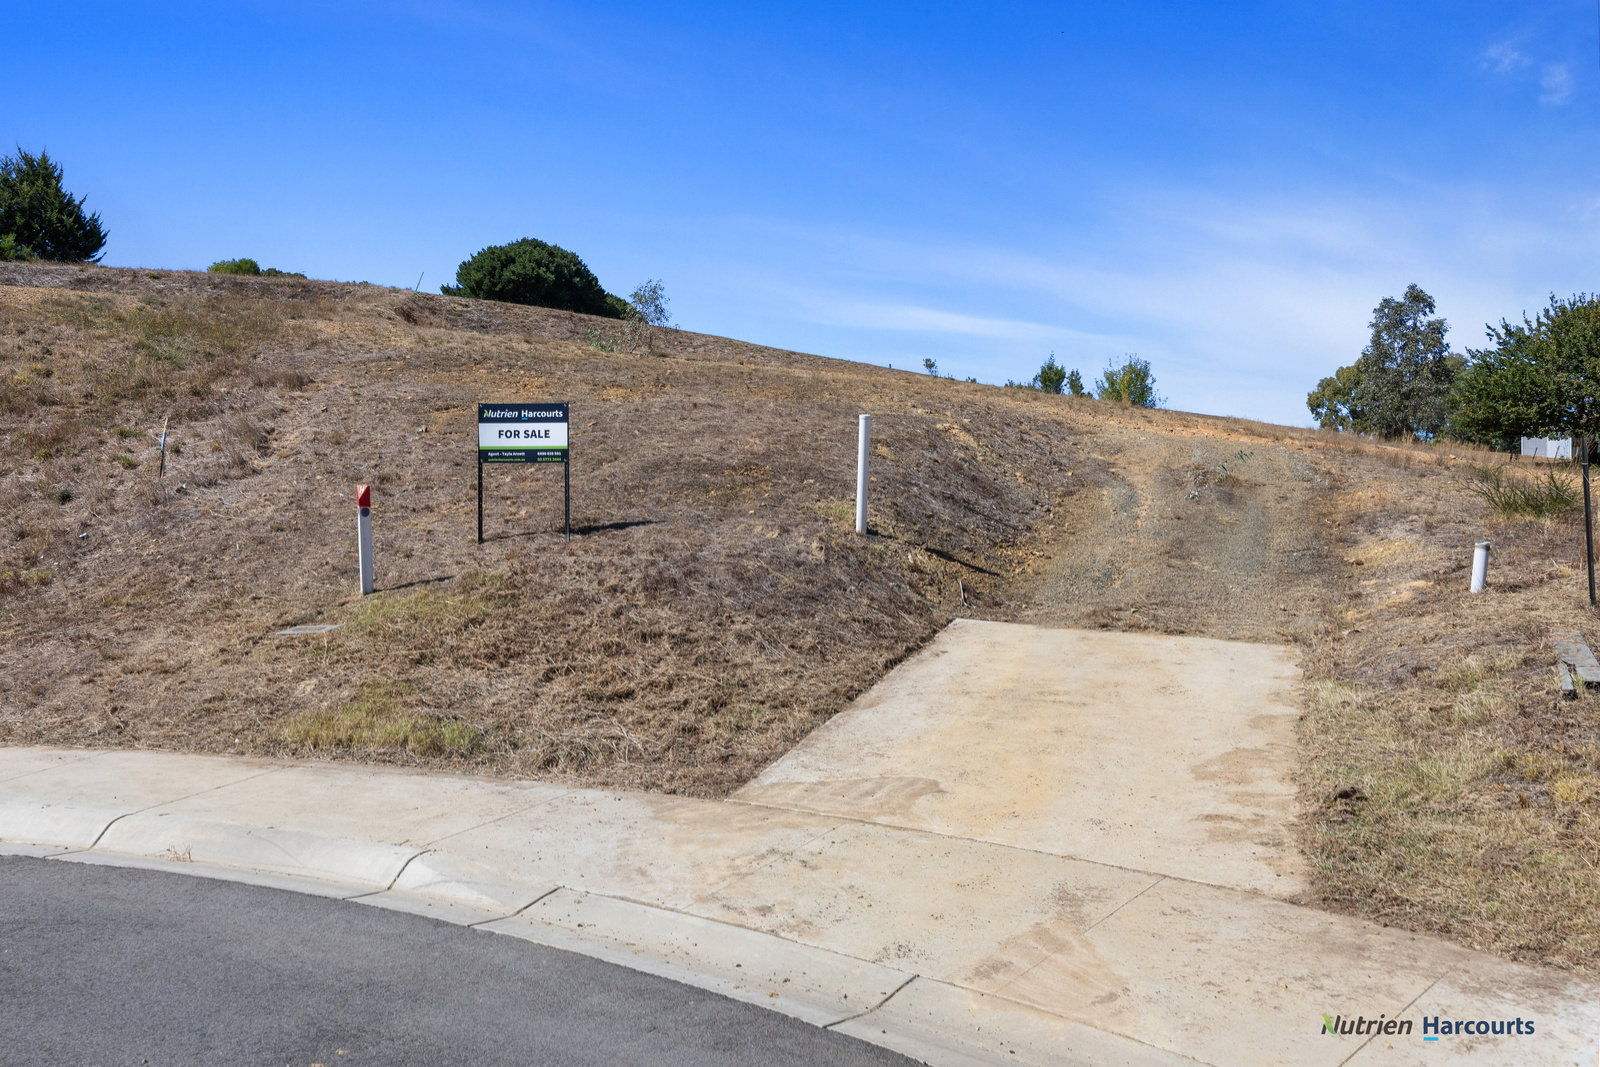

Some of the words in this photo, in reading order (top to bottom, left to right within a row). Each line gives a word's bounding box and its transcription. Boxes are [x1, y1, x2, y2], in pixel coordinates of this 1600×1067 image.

[483, 409, 518, 418] Nutrien
[521, 409, 563, 418] Harcourts
[498, 429, 520, 439] FOR
[523, 429, 551, 439] SALE
